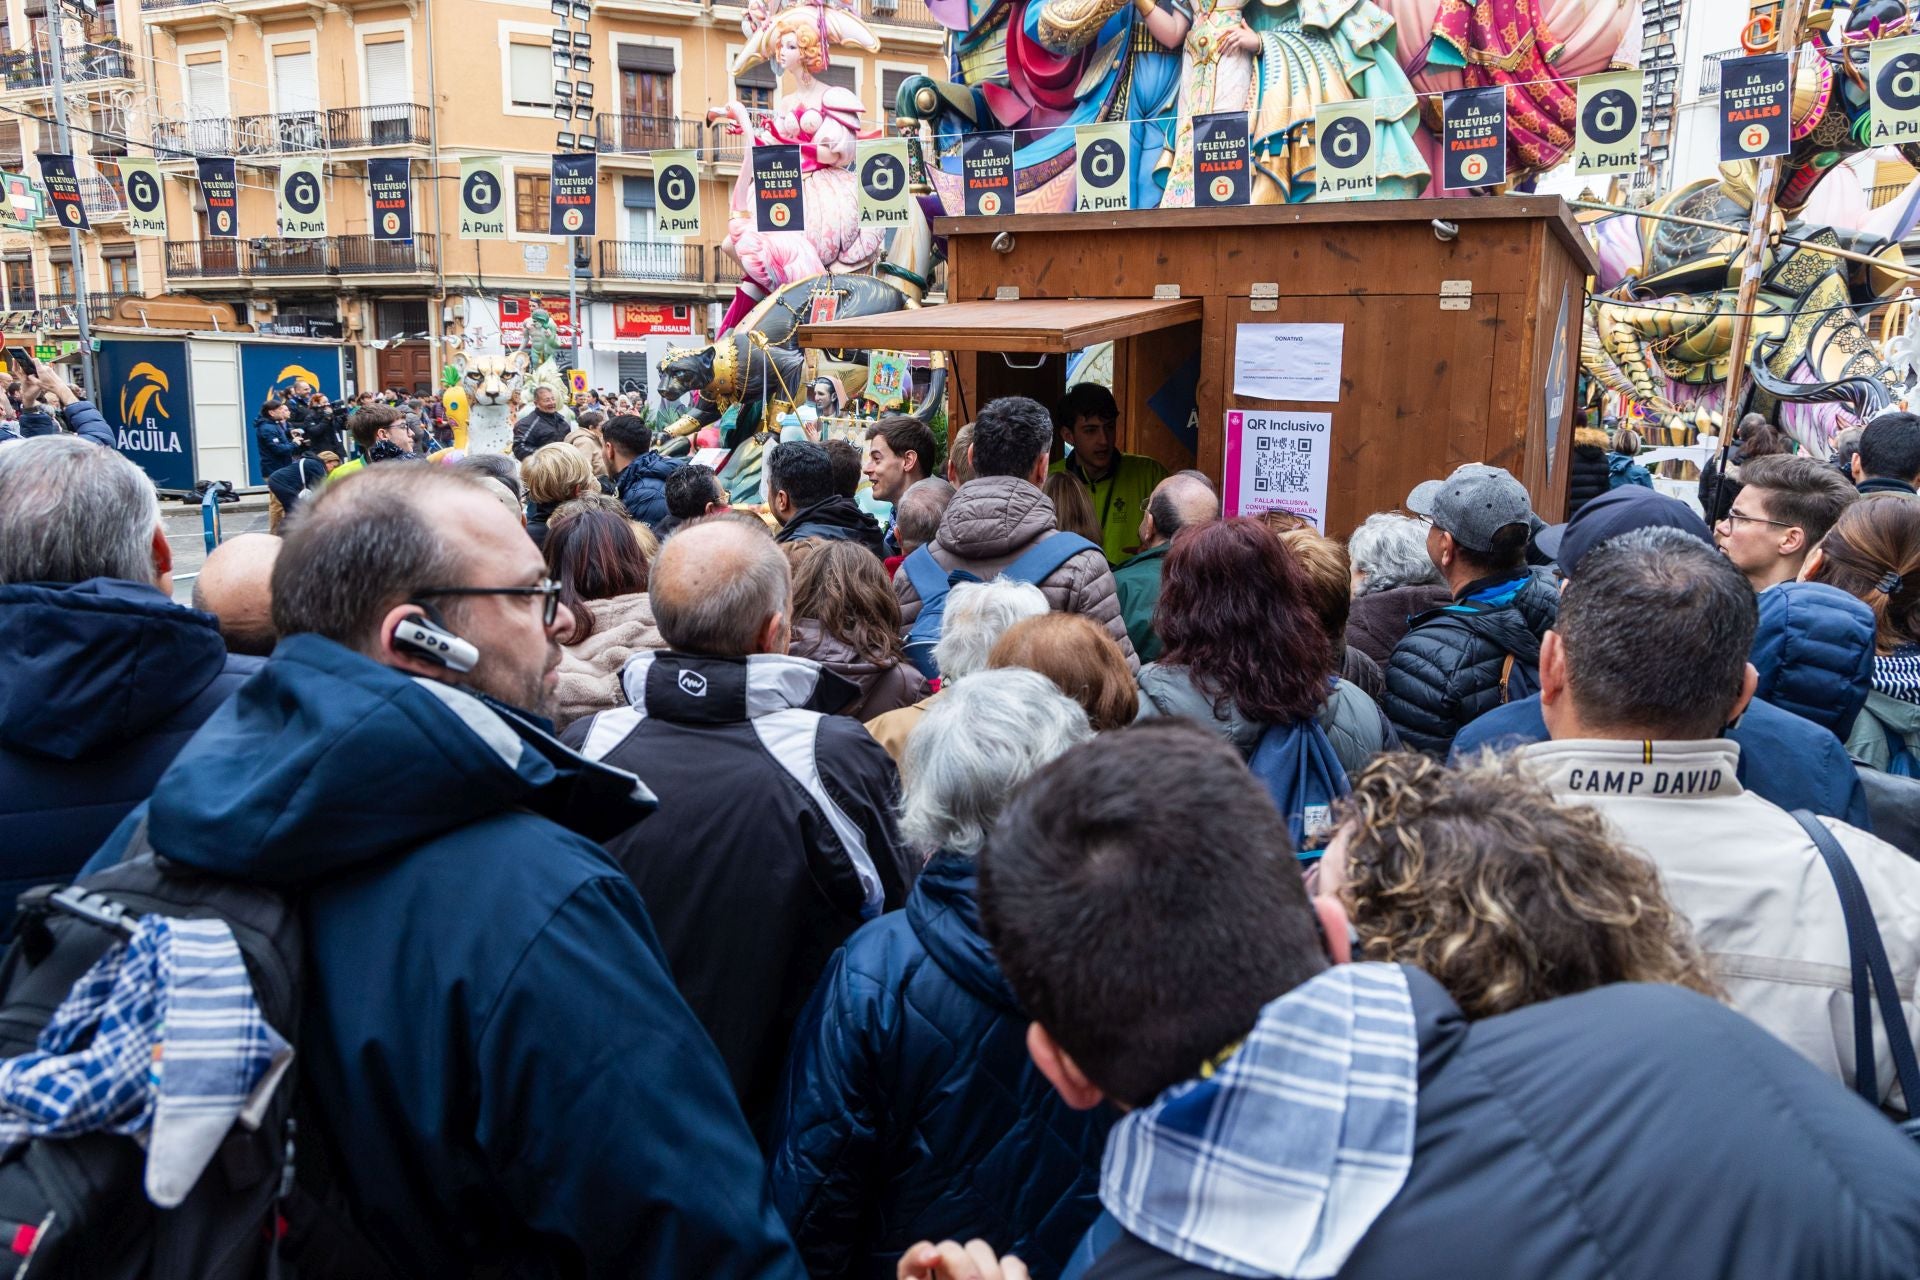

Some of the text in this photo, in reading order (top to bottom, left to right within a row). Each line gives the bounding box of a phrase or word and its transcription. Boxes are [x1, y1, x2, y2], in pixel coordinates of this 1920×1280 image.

[1746, 75, 1761, 85] LA
[1724, 80, 1785, 99] TELEVISIÓ
[1734, 96, 1774, 109] DE LES
[1467, 107, 1480, 116] LA
[1728, 105, 1781, 123] FALLES
[1448, 113, 1501, 128] TELEVISIÓ
[1215, 131, 1227, 139] LA
[1456, 127, 1491, 138] DE LES
[1875, 120, 1889, 137] À
[1197, 137, 1246, 151] TELEVISIÓ
[1451, 136, 1498, 151] FALLES
[983, 149, 994, 157] LA
[1206, 151, 1237, 160] DE LES
[772, 161, 782, 170] LA
[965, 155, 1011, 168] TELEVISIÓ
[1200, 160, 1243, 173] FALLES
[1578, 152, 1637, 168] À Punt
[385, 174, 393, 182] LA
[757, 168, 799, 179] TELEVISIÓ
[974, 167, 1004, 177] DE LES
[554, 176, 593, 185] TELEVISIÓ
[765, 180, 792, 188] DE LES
[969, 176, 1009, 189] FALLES
[1320, 176, 1373, 193] À Punt
[379, 191, 389, 199] DE
[561, 187, 587, 195] DE LES
[760, 188, 797, 199] FALLES
[556, 195, 591, 205] FALLES
[1080, 195, 1127, 210] À Punt
[861, 207, 908, 222] À Punt
[132, 216, 165, 231] À Punt
[286, 218, 325, 233] À Punt
[462, 219, 503, 233] À Punt
[660, 216, 699, 231] À Punt
[626, 312, 663, 324] Kebap
[650, 325, 690, 333] JERUSALEM
[146, 417, 158, 430] EL
[1247, 418, 1325, 433] QR Inclusivo
[117, 425, 183, 453] ÁGUILA
[1275, 498, 1309, 506] INCLUSIVA
[1569, 769, 1722, 794] CAMP DAVID
